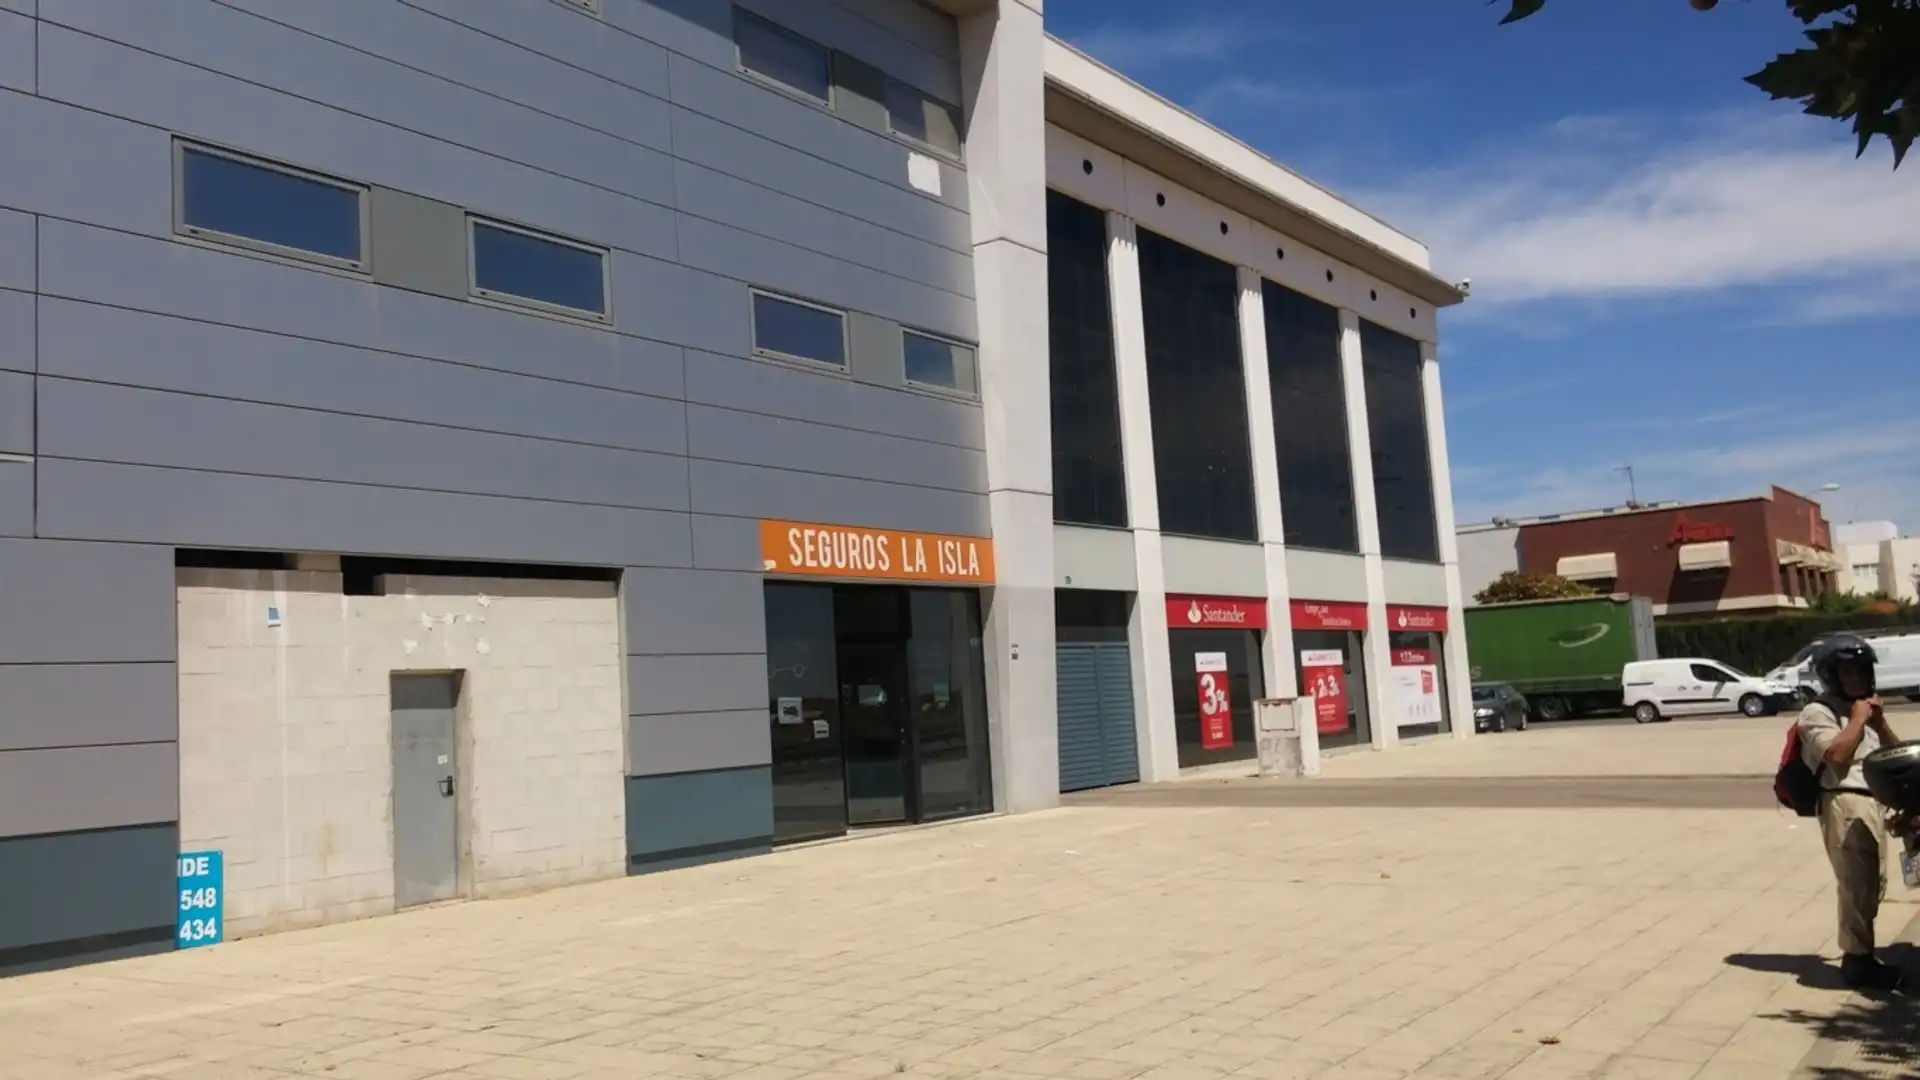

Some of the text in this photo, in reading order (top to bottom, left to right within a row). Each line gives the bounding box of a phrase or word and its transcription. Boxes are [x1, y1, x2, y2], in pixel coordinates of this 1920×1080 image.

[788, 527, 980, 576] SEGUROS LA ISLA
[1202, 604, 1246, 623] Santander
[180, 887, 217, 911] 548
[179, 917, 217, 942] 434
